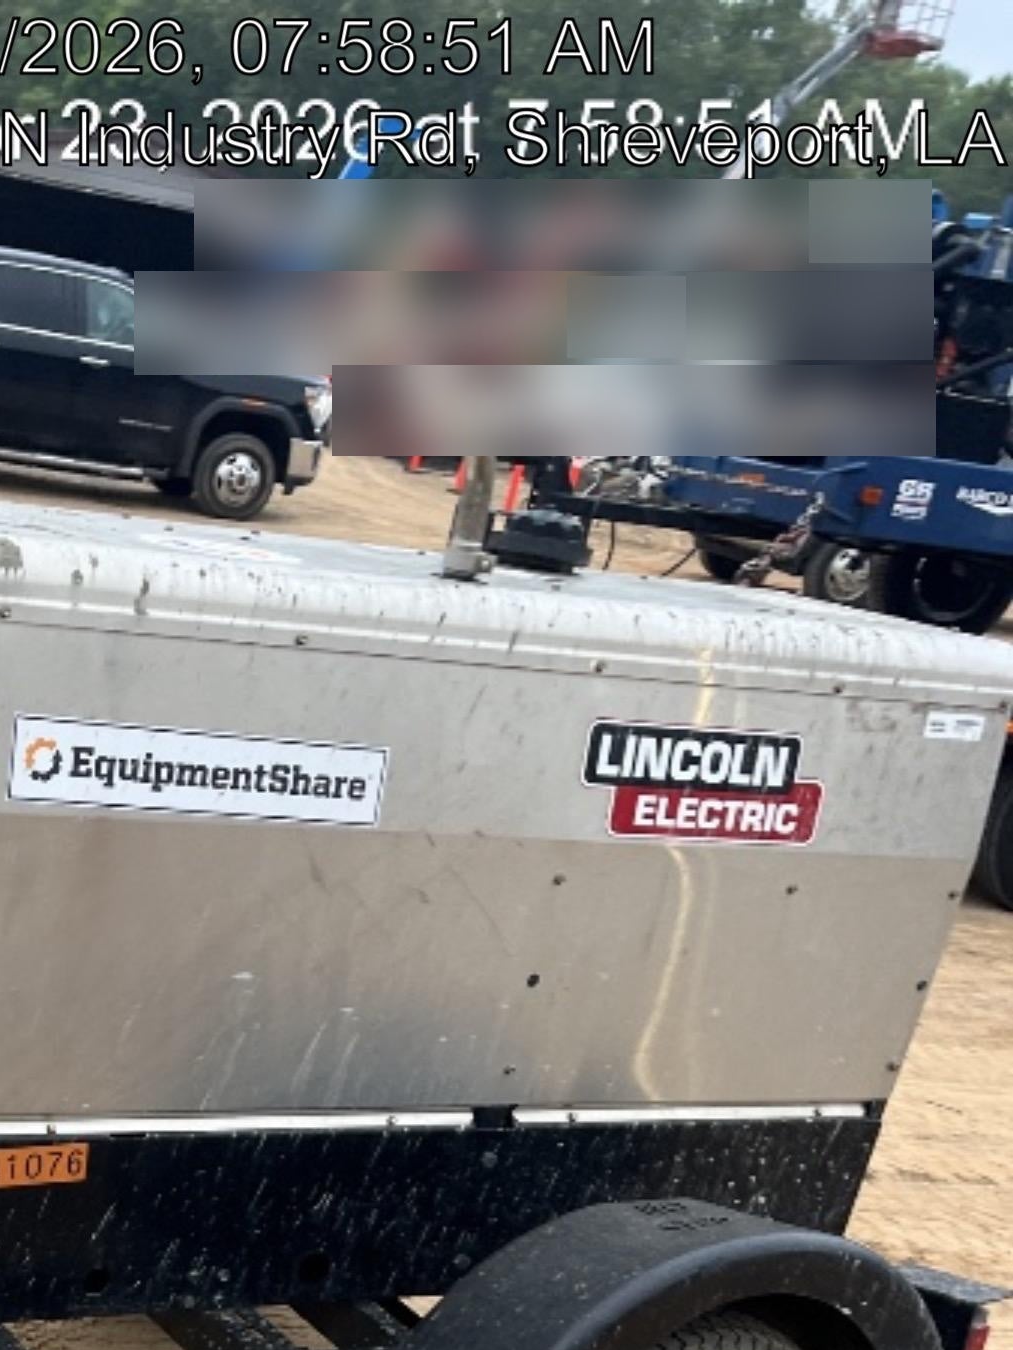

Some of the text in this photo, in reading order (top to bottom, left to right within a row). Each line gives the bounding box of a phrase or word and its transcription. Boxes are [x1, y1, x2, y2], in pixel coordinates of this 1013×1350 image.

[69, 746, 367, 801] EquipmentShare
[595, 733, 790, 787] LINCOLN
[633, 794, 800, 834] ELECTRIC
